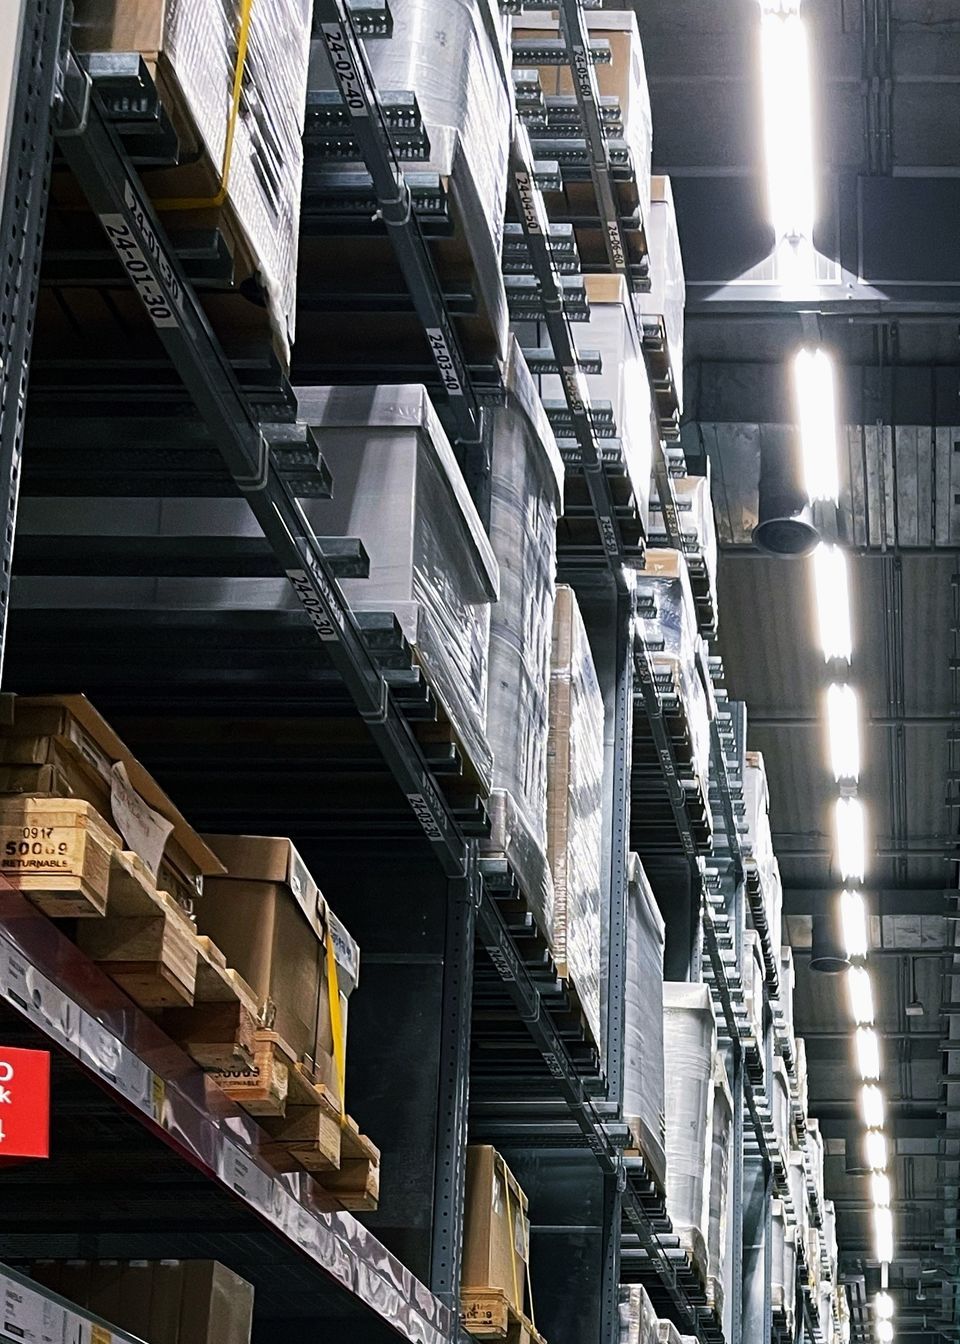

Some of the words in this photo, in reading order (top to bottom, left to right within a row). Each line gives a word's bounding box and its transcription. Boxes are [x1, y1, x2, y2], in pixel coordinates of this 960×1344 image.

[326, 32, 363, 108] 24-02-40
[106, 225, 171, 319] 24-01-30
[429, 334, 459, 390] 24-03-40
[288, 577, 334, 636] 24-02-30
[23, 827, 54, 839] 0917
